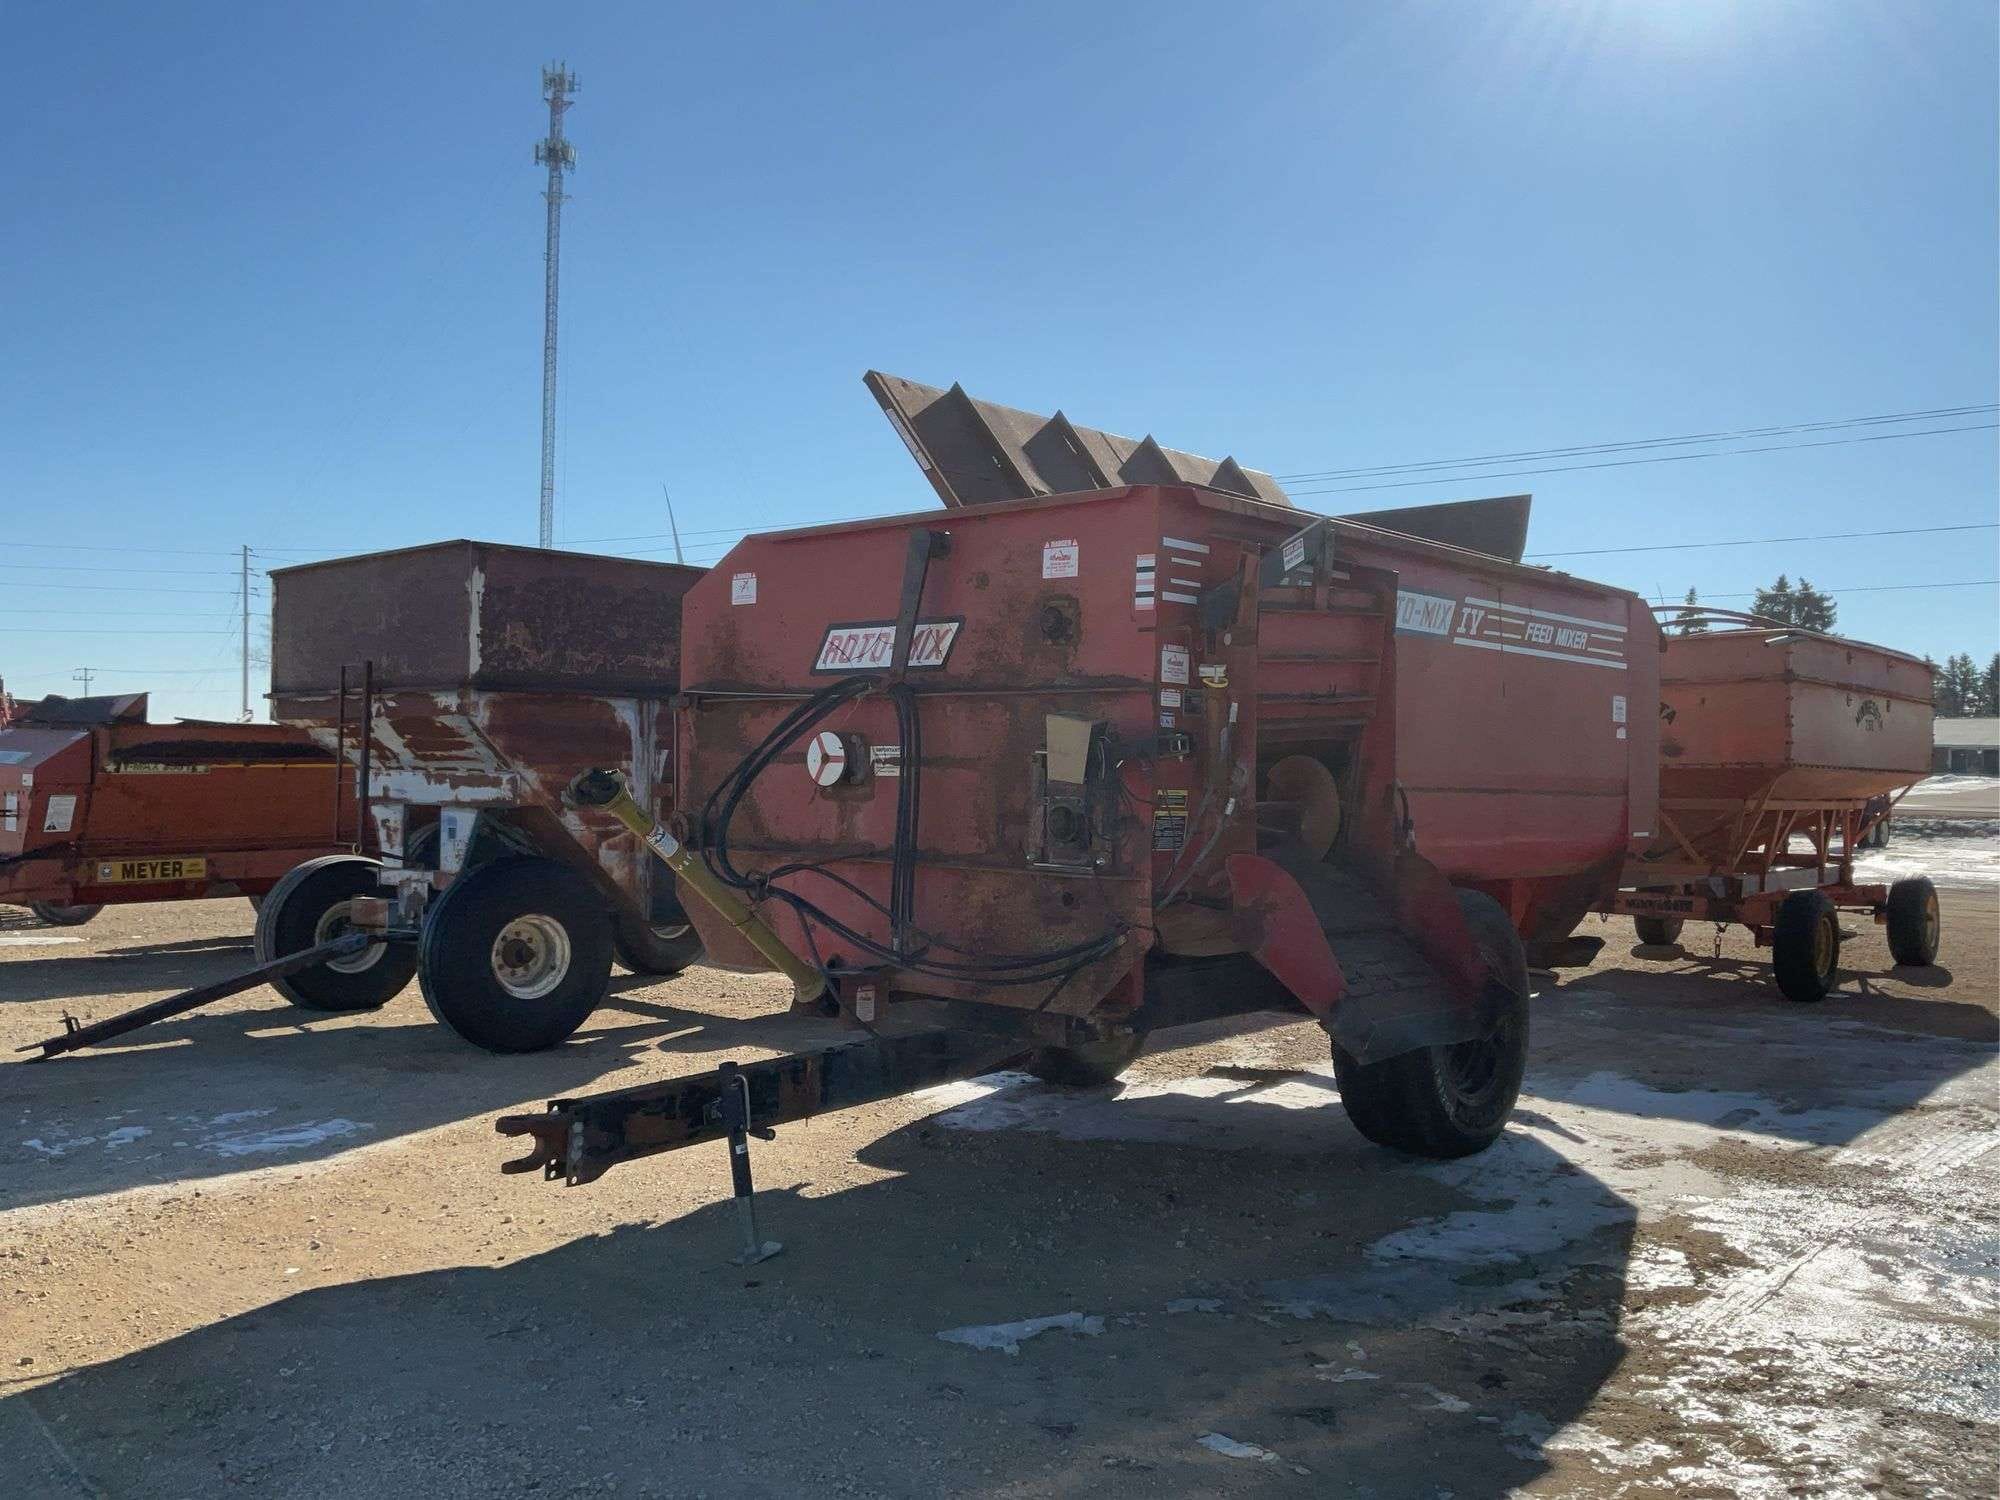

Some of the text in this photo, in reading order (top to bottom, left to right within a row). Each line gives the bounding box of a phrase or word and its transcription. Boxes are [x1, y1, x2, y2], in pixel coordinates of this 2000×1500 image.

[1525, 622, 1554, 644] FEED
[1555, 628, 1588, 650] MIXER
[121, 861, 183, 880] MEYER
